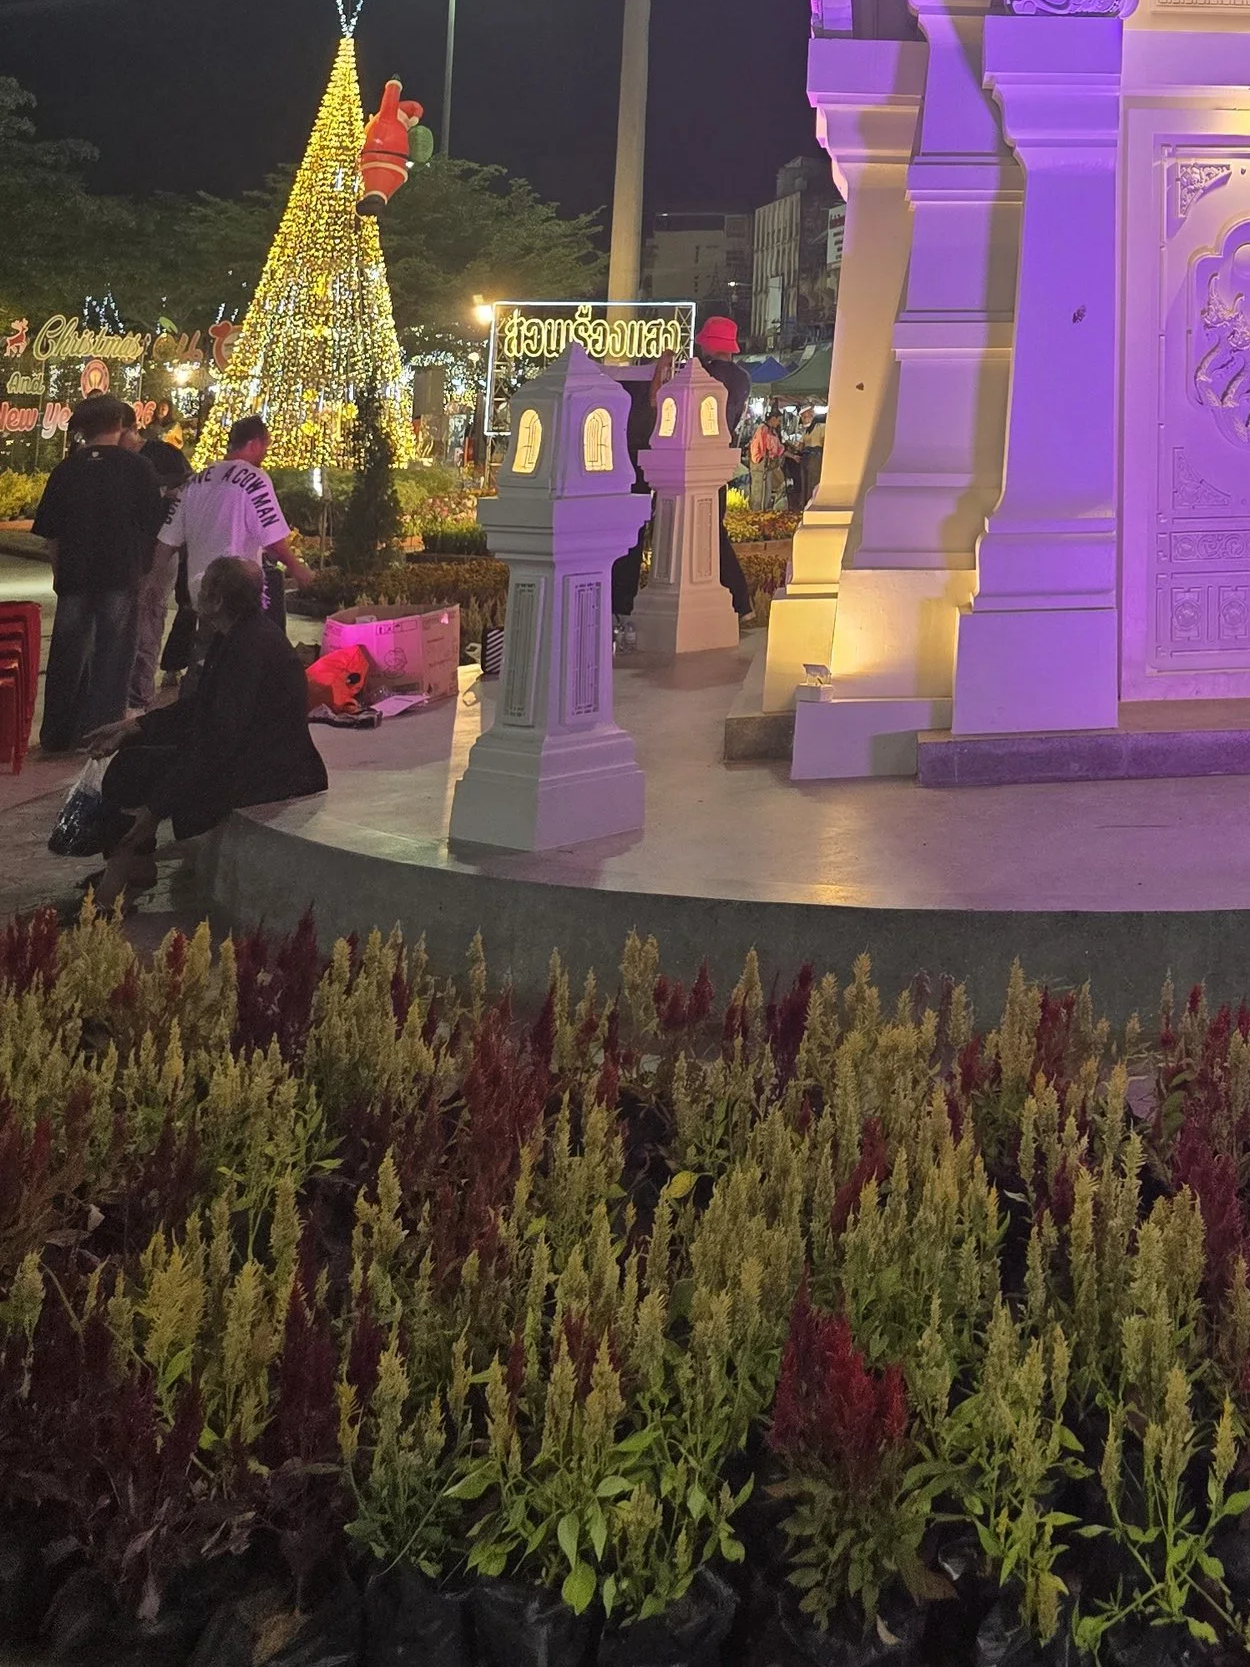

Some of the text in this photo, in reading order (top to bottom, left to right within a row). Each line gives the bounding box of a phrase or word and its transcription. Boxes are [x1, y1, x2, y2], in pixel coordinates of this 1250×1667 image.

[33, 314, 144, 361] Christmas
[6, 371, 45, 395] And
[251, 492, 280, 528] MAN
